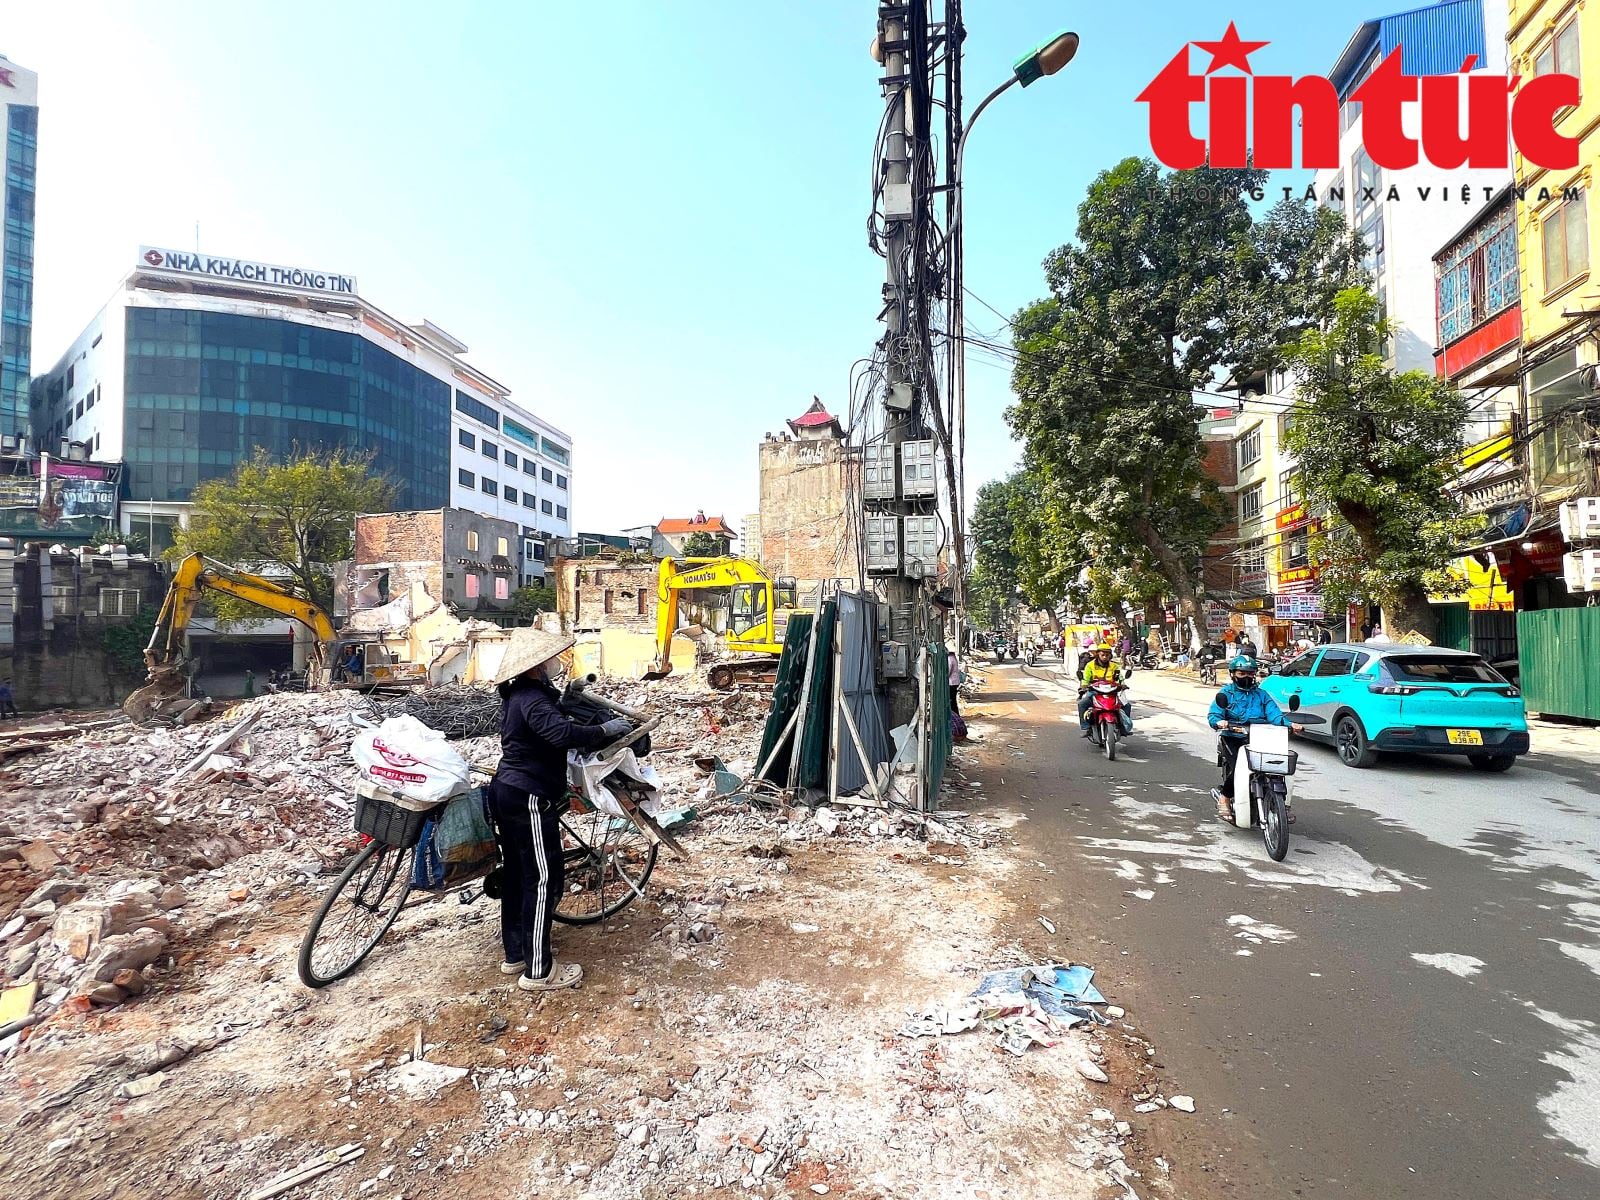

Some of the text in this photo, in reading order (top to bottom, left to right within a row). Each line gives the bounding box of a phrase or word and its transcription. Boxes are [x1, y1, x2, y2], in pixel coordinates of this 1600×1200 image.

[165, 253, 204, 272] NHÀ
[206, 258, 267, 281] KHÁCH
[270, 268, 326, 289] THÔNG
[683, 571, 716, 584] KOMATSU
